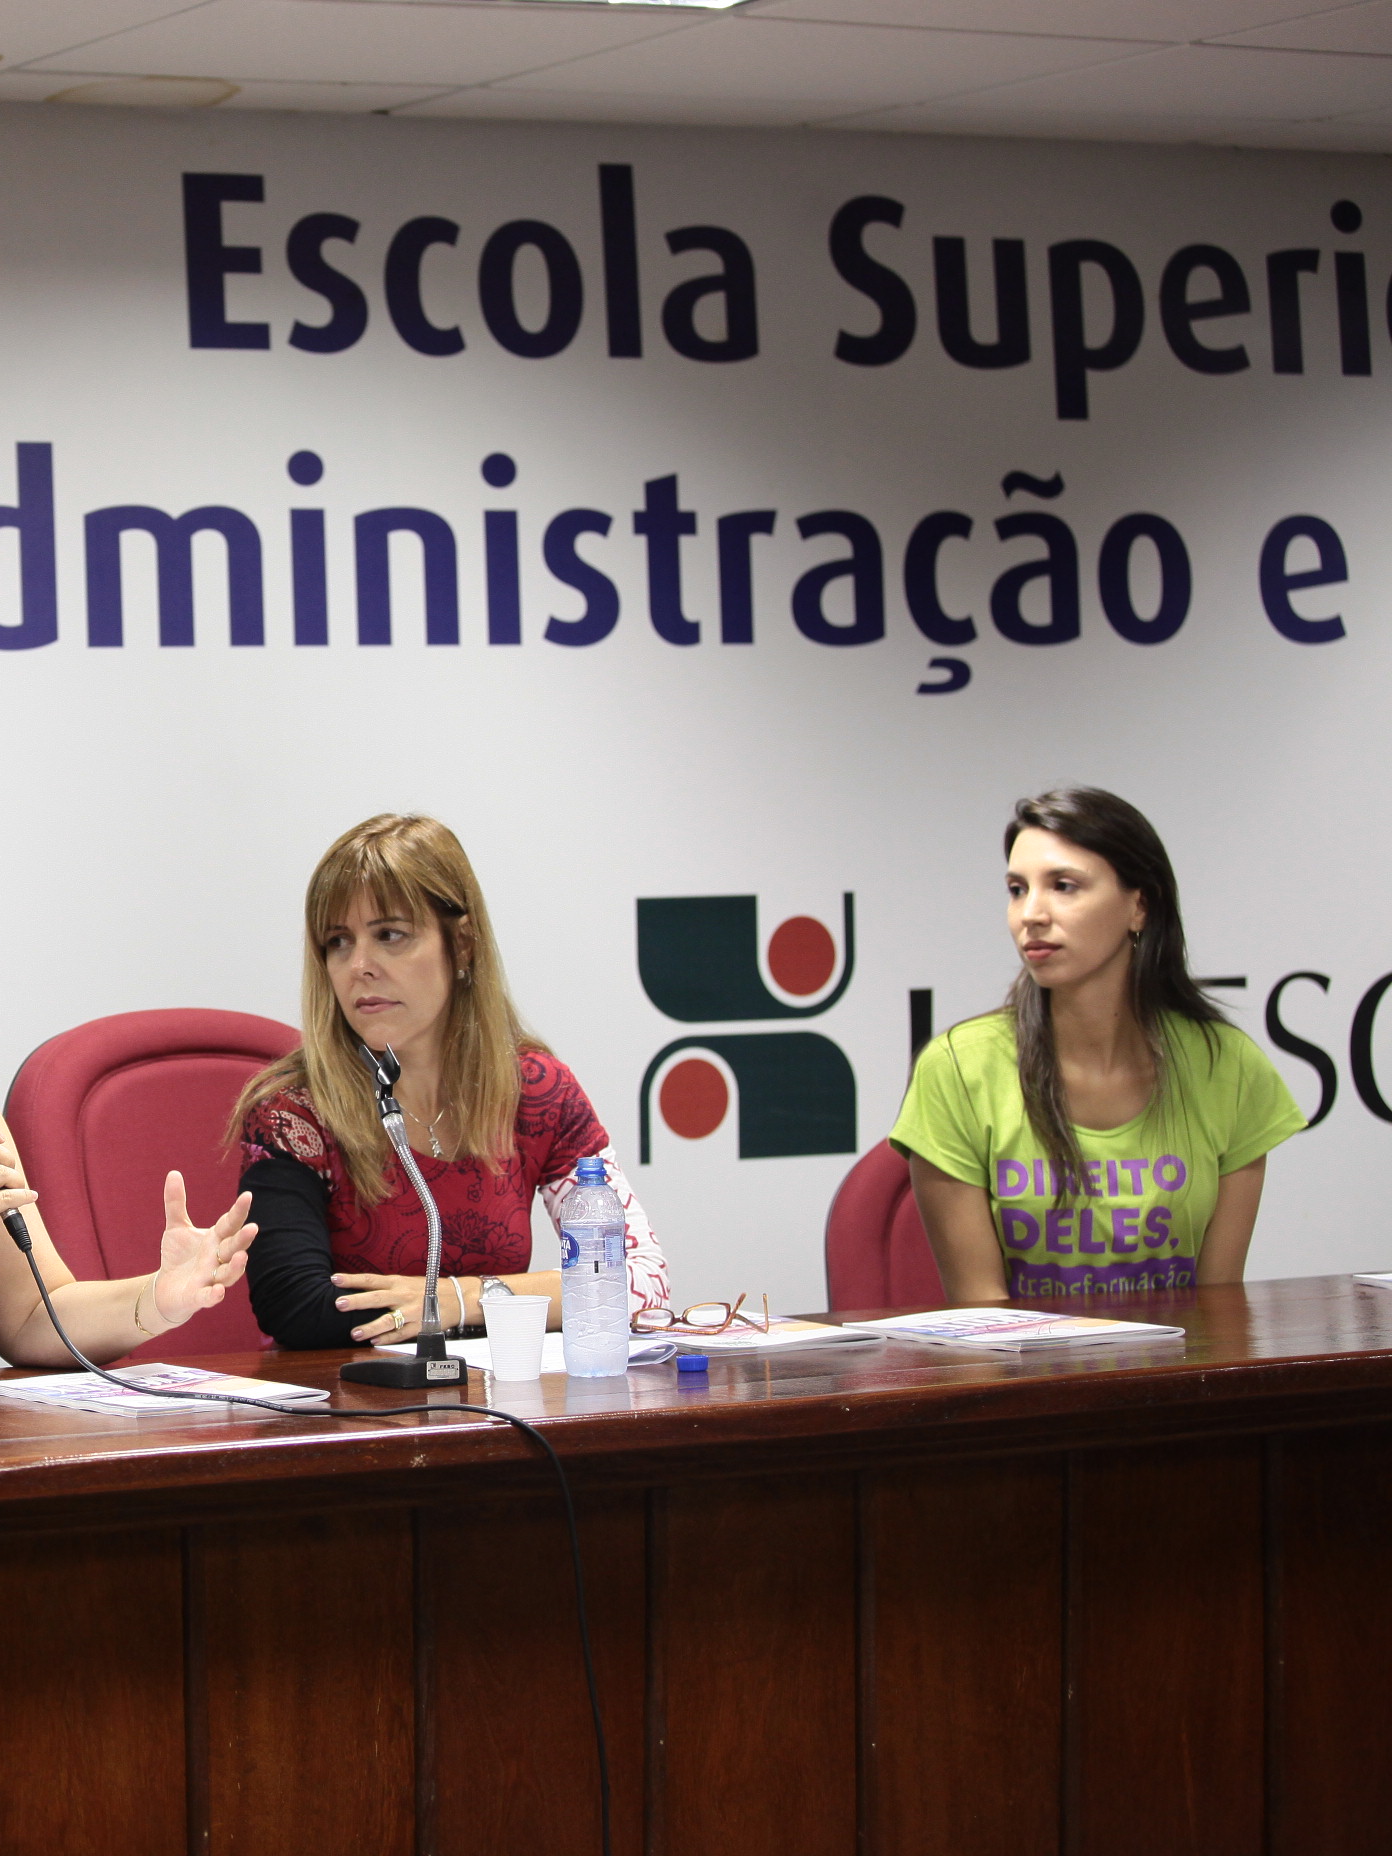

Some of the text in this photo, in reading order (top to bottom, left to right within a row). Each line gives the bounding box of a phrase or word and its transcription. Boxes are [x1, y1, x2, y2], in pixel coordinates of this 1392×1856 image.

[181, 162, 1392, 420] Escola Superi
[1258, 513, 1350, 647] e
[996, 1153, 1187, 1198] DIREITO
[1001, 1205, 1179, 1254] DELES,
